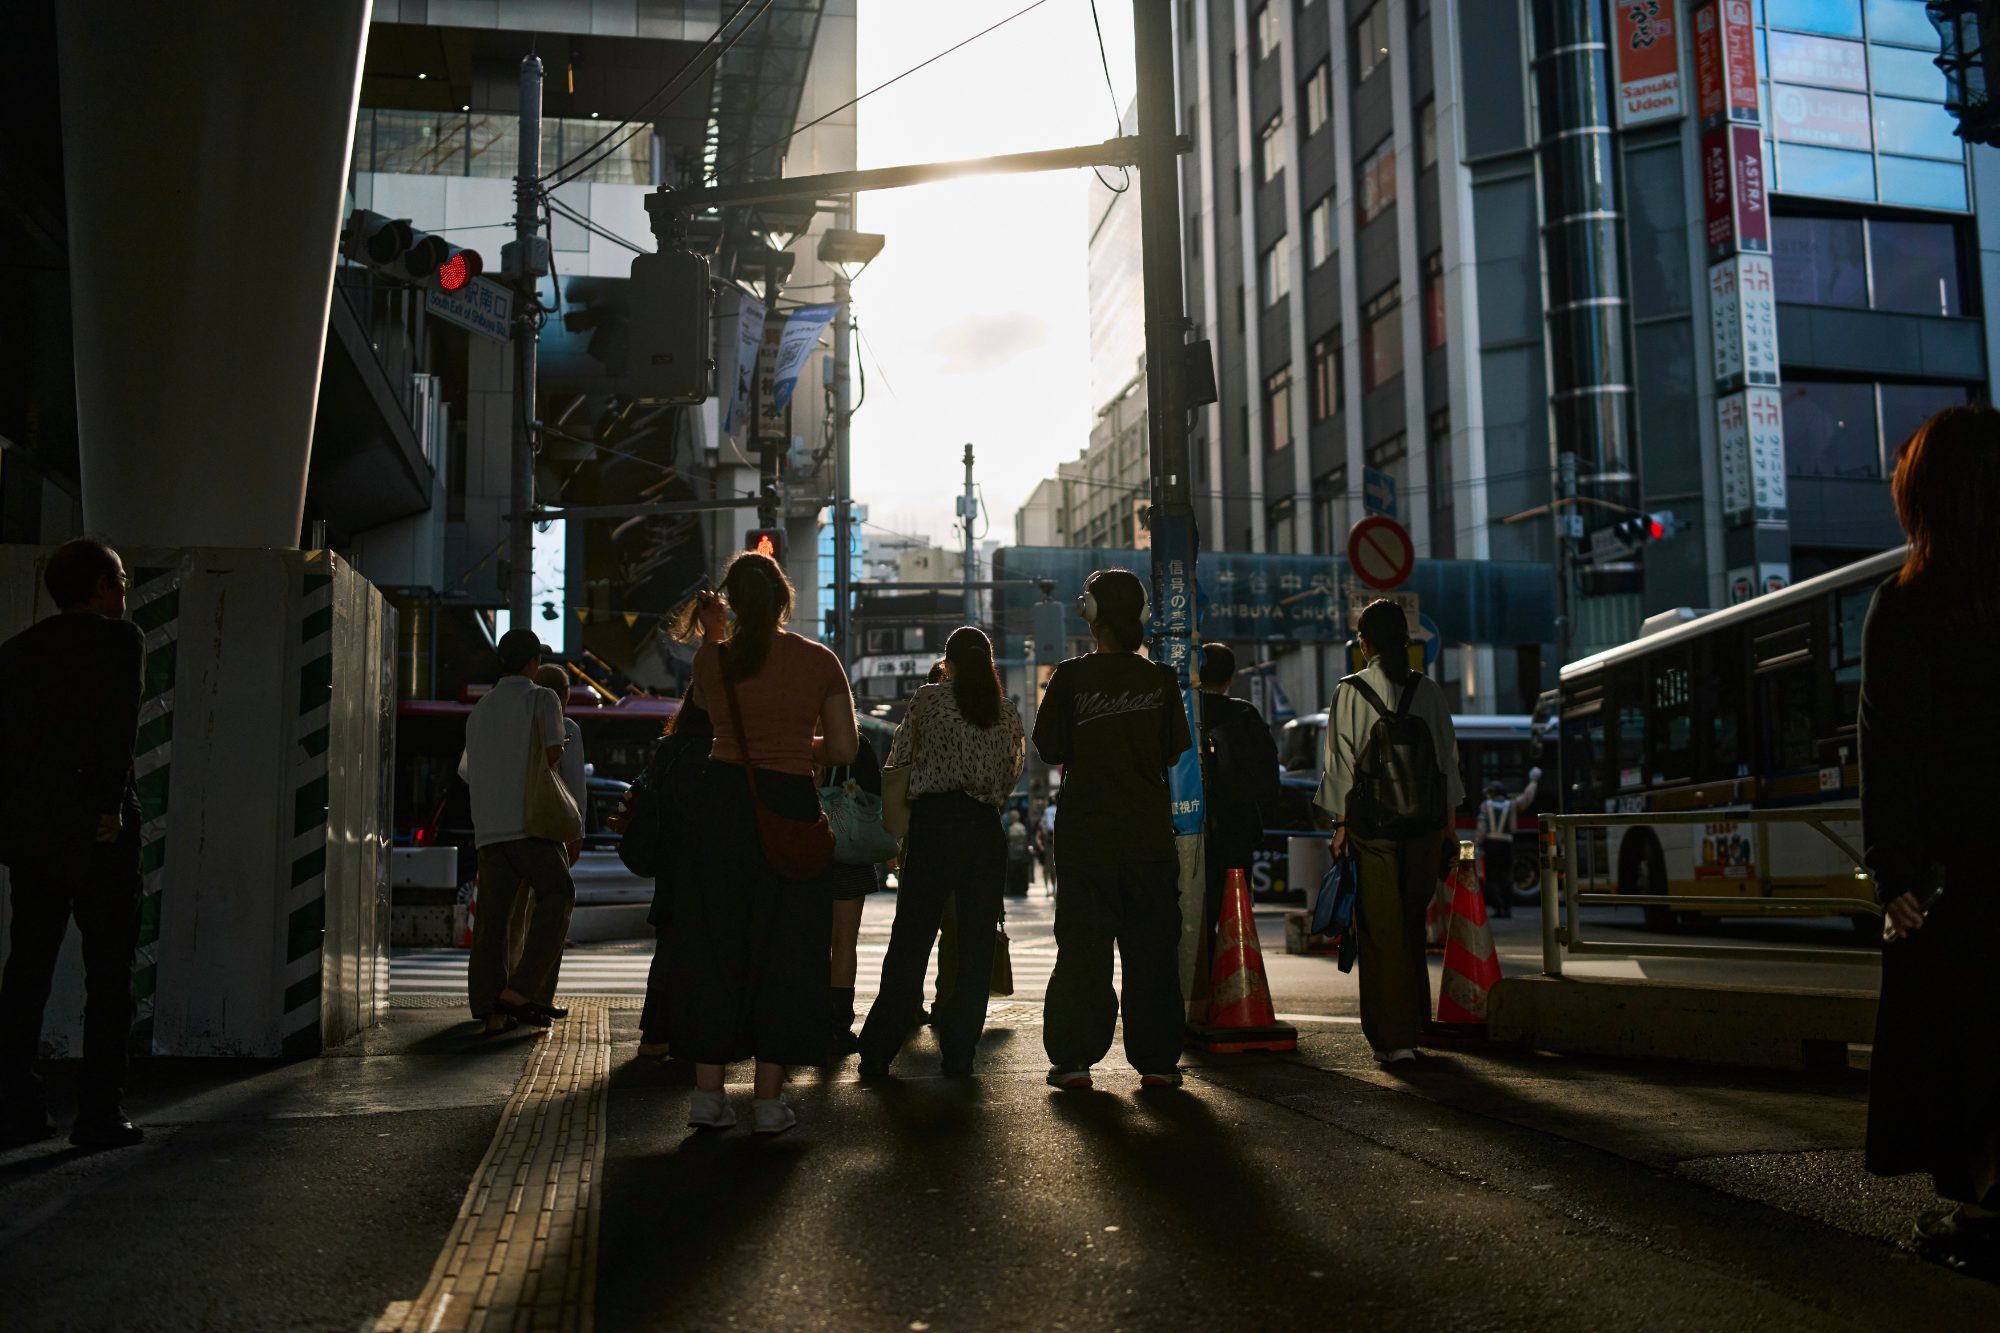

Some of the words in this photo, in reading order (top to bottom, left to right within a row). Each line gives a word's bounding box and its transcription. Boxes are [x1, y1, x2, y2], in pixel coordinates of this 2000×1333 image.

[1623, 77, 1678, 98] Sanuki
[1628, 95, 1673, 113] Udon
[1712, 146, 1726, 204] ASTRA
[1745, 154, 1761, 212] ASTRA
[1210, 603, 1284, 619] SHIBUYA
[1073, 688, 1163, 716] Michael
